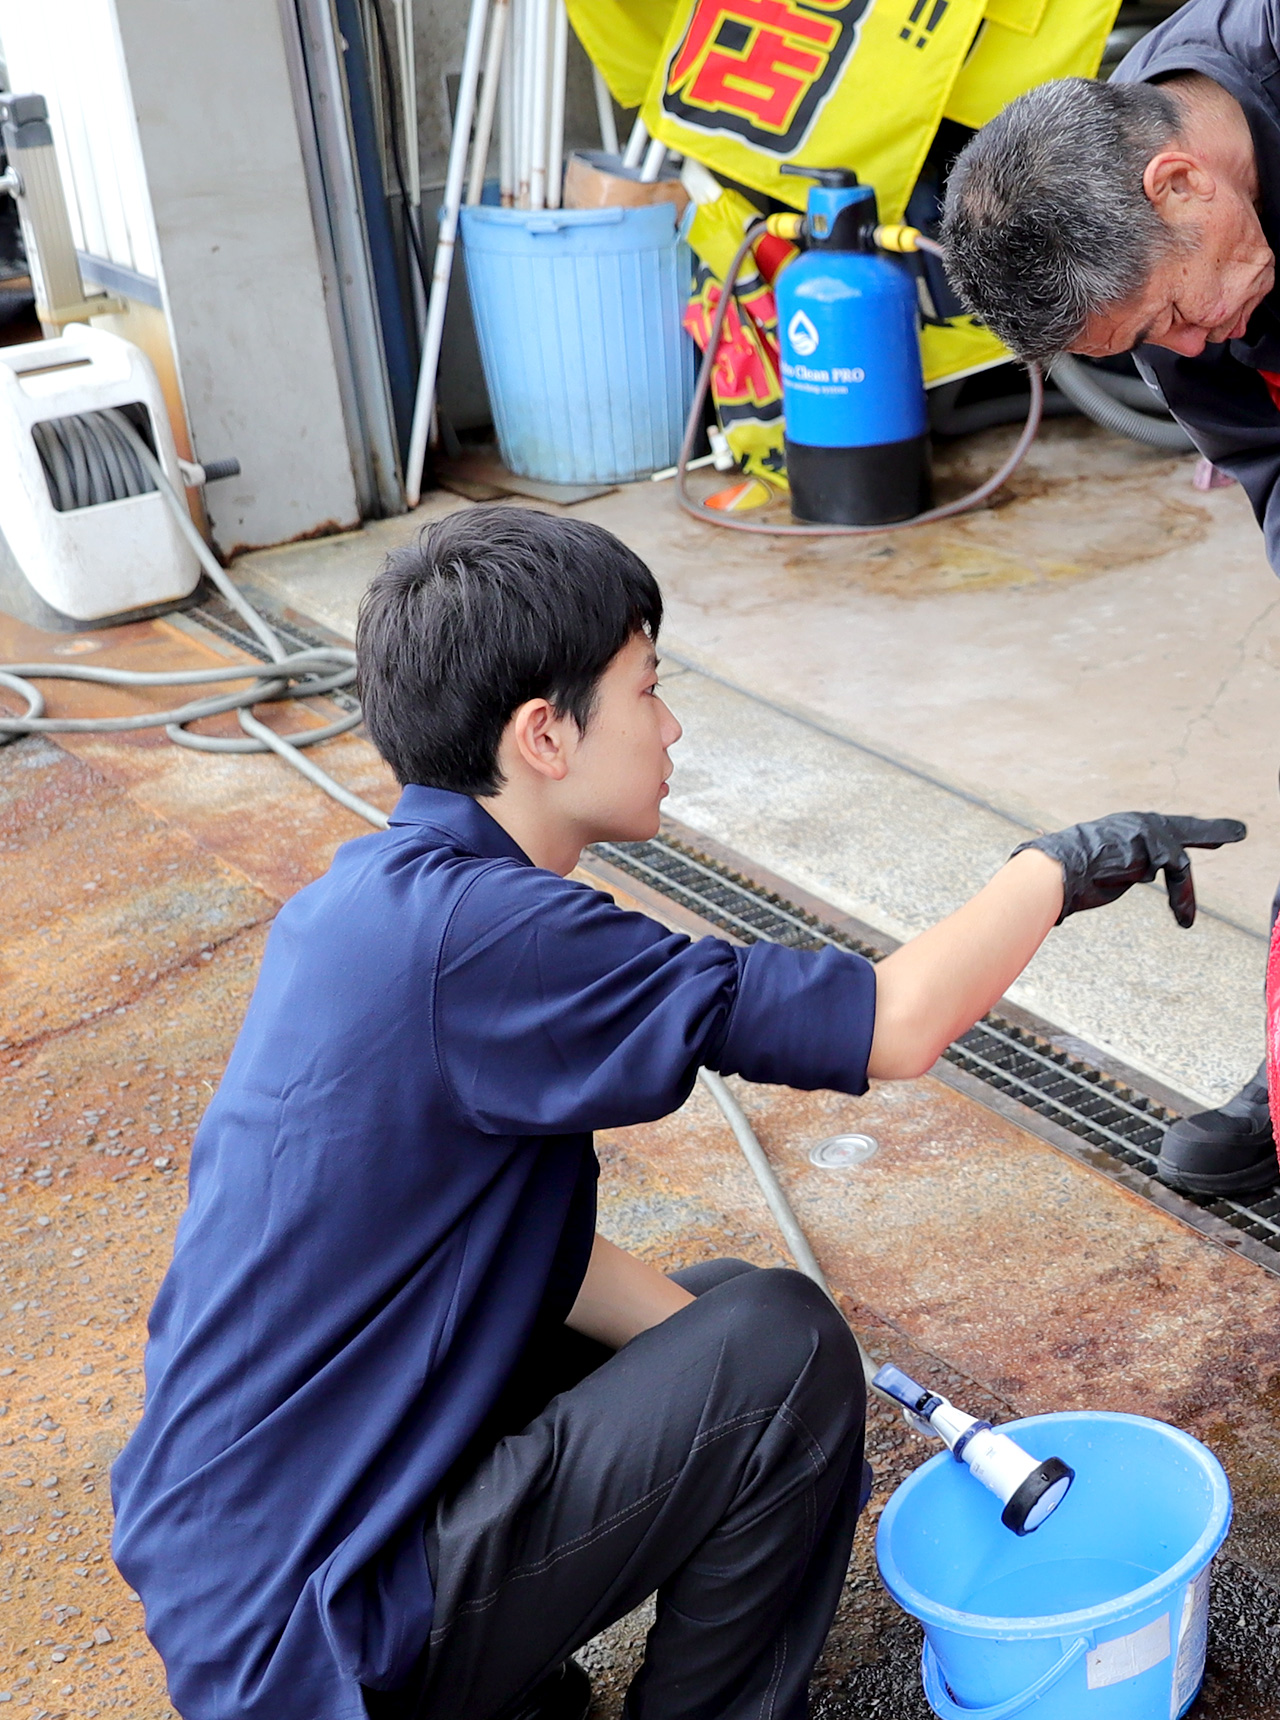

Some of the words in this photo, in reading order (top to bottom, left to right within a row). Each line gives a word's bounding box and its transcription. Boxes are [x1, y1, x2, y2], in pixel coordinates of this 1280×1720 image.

[670, 0, 843, 134] 店
[795, 365, 829, 382] Clean
[832, 367, 865, 383] PRO
